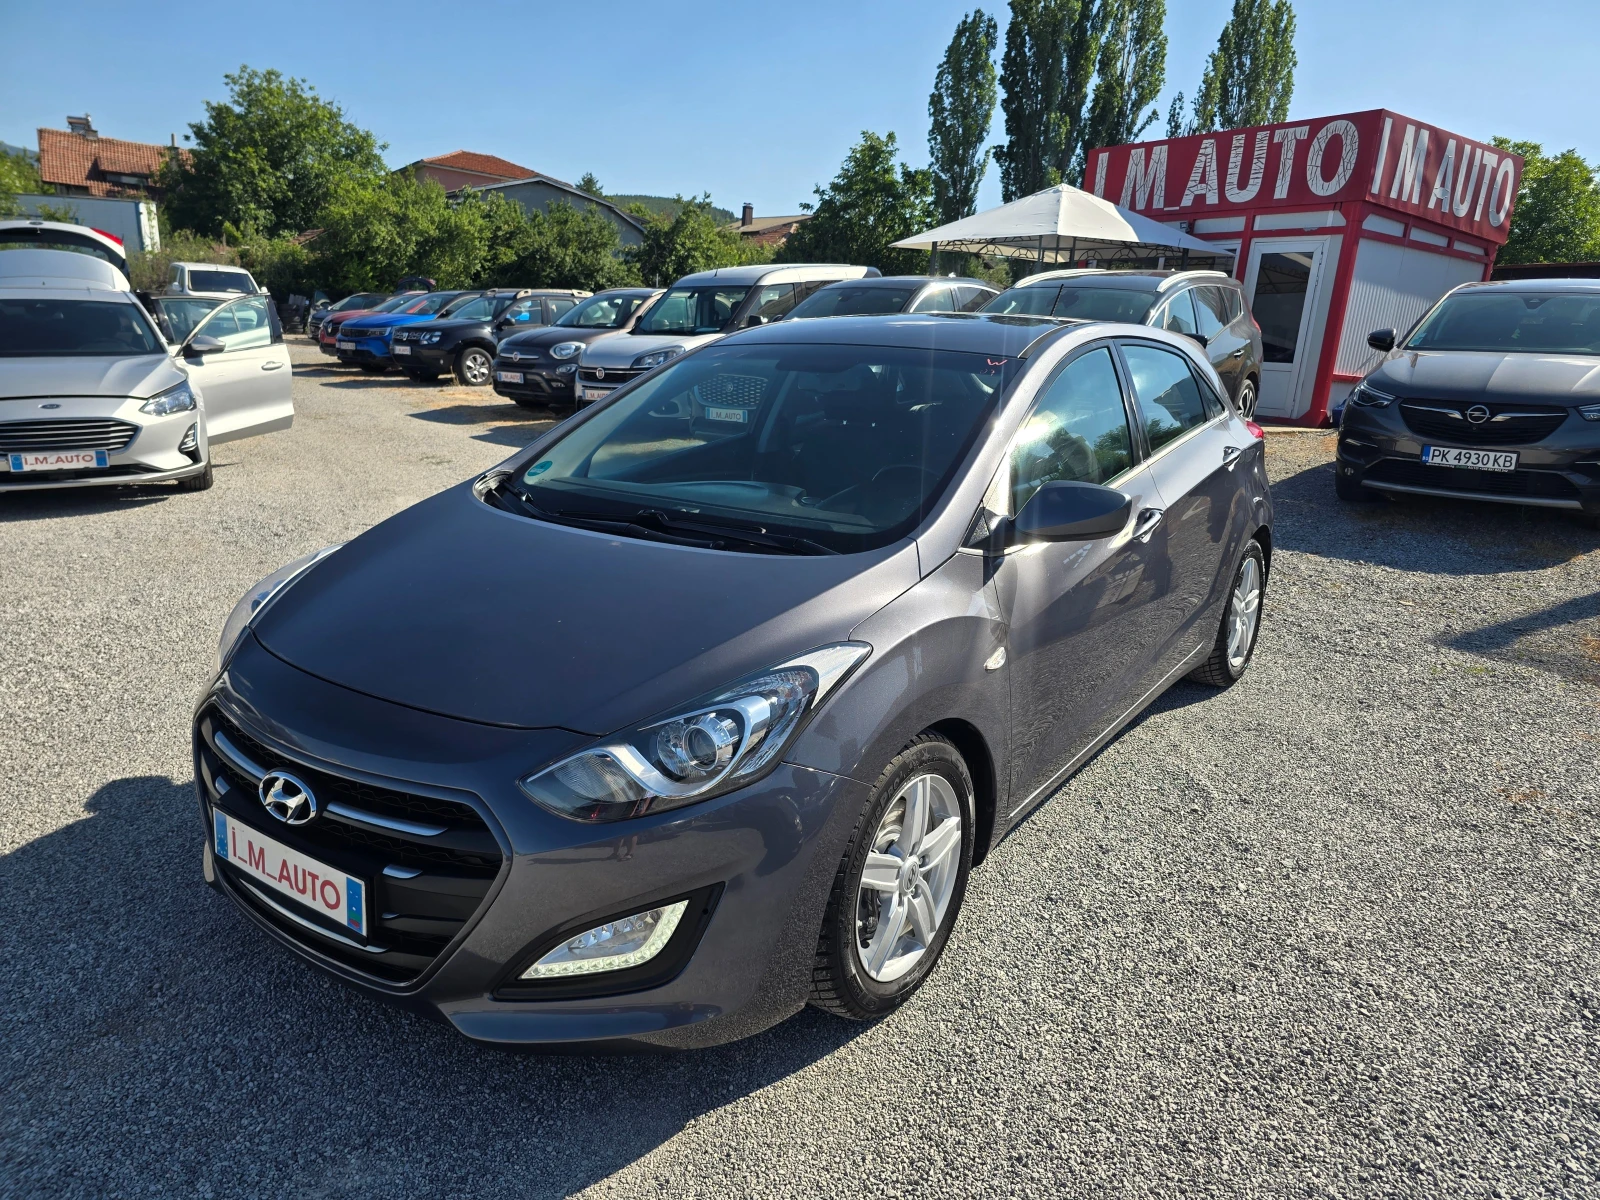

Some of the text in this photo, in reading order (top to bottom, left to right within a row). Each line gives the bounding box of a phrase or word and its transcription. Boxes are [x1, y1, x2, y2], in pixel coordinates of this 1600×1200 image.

[1371, 117, 1515, 227] I M AUTO
[24, 454, 94, 465] I_M_AUTO
[1431, 449, 1514, 468] PK 4930 KB
